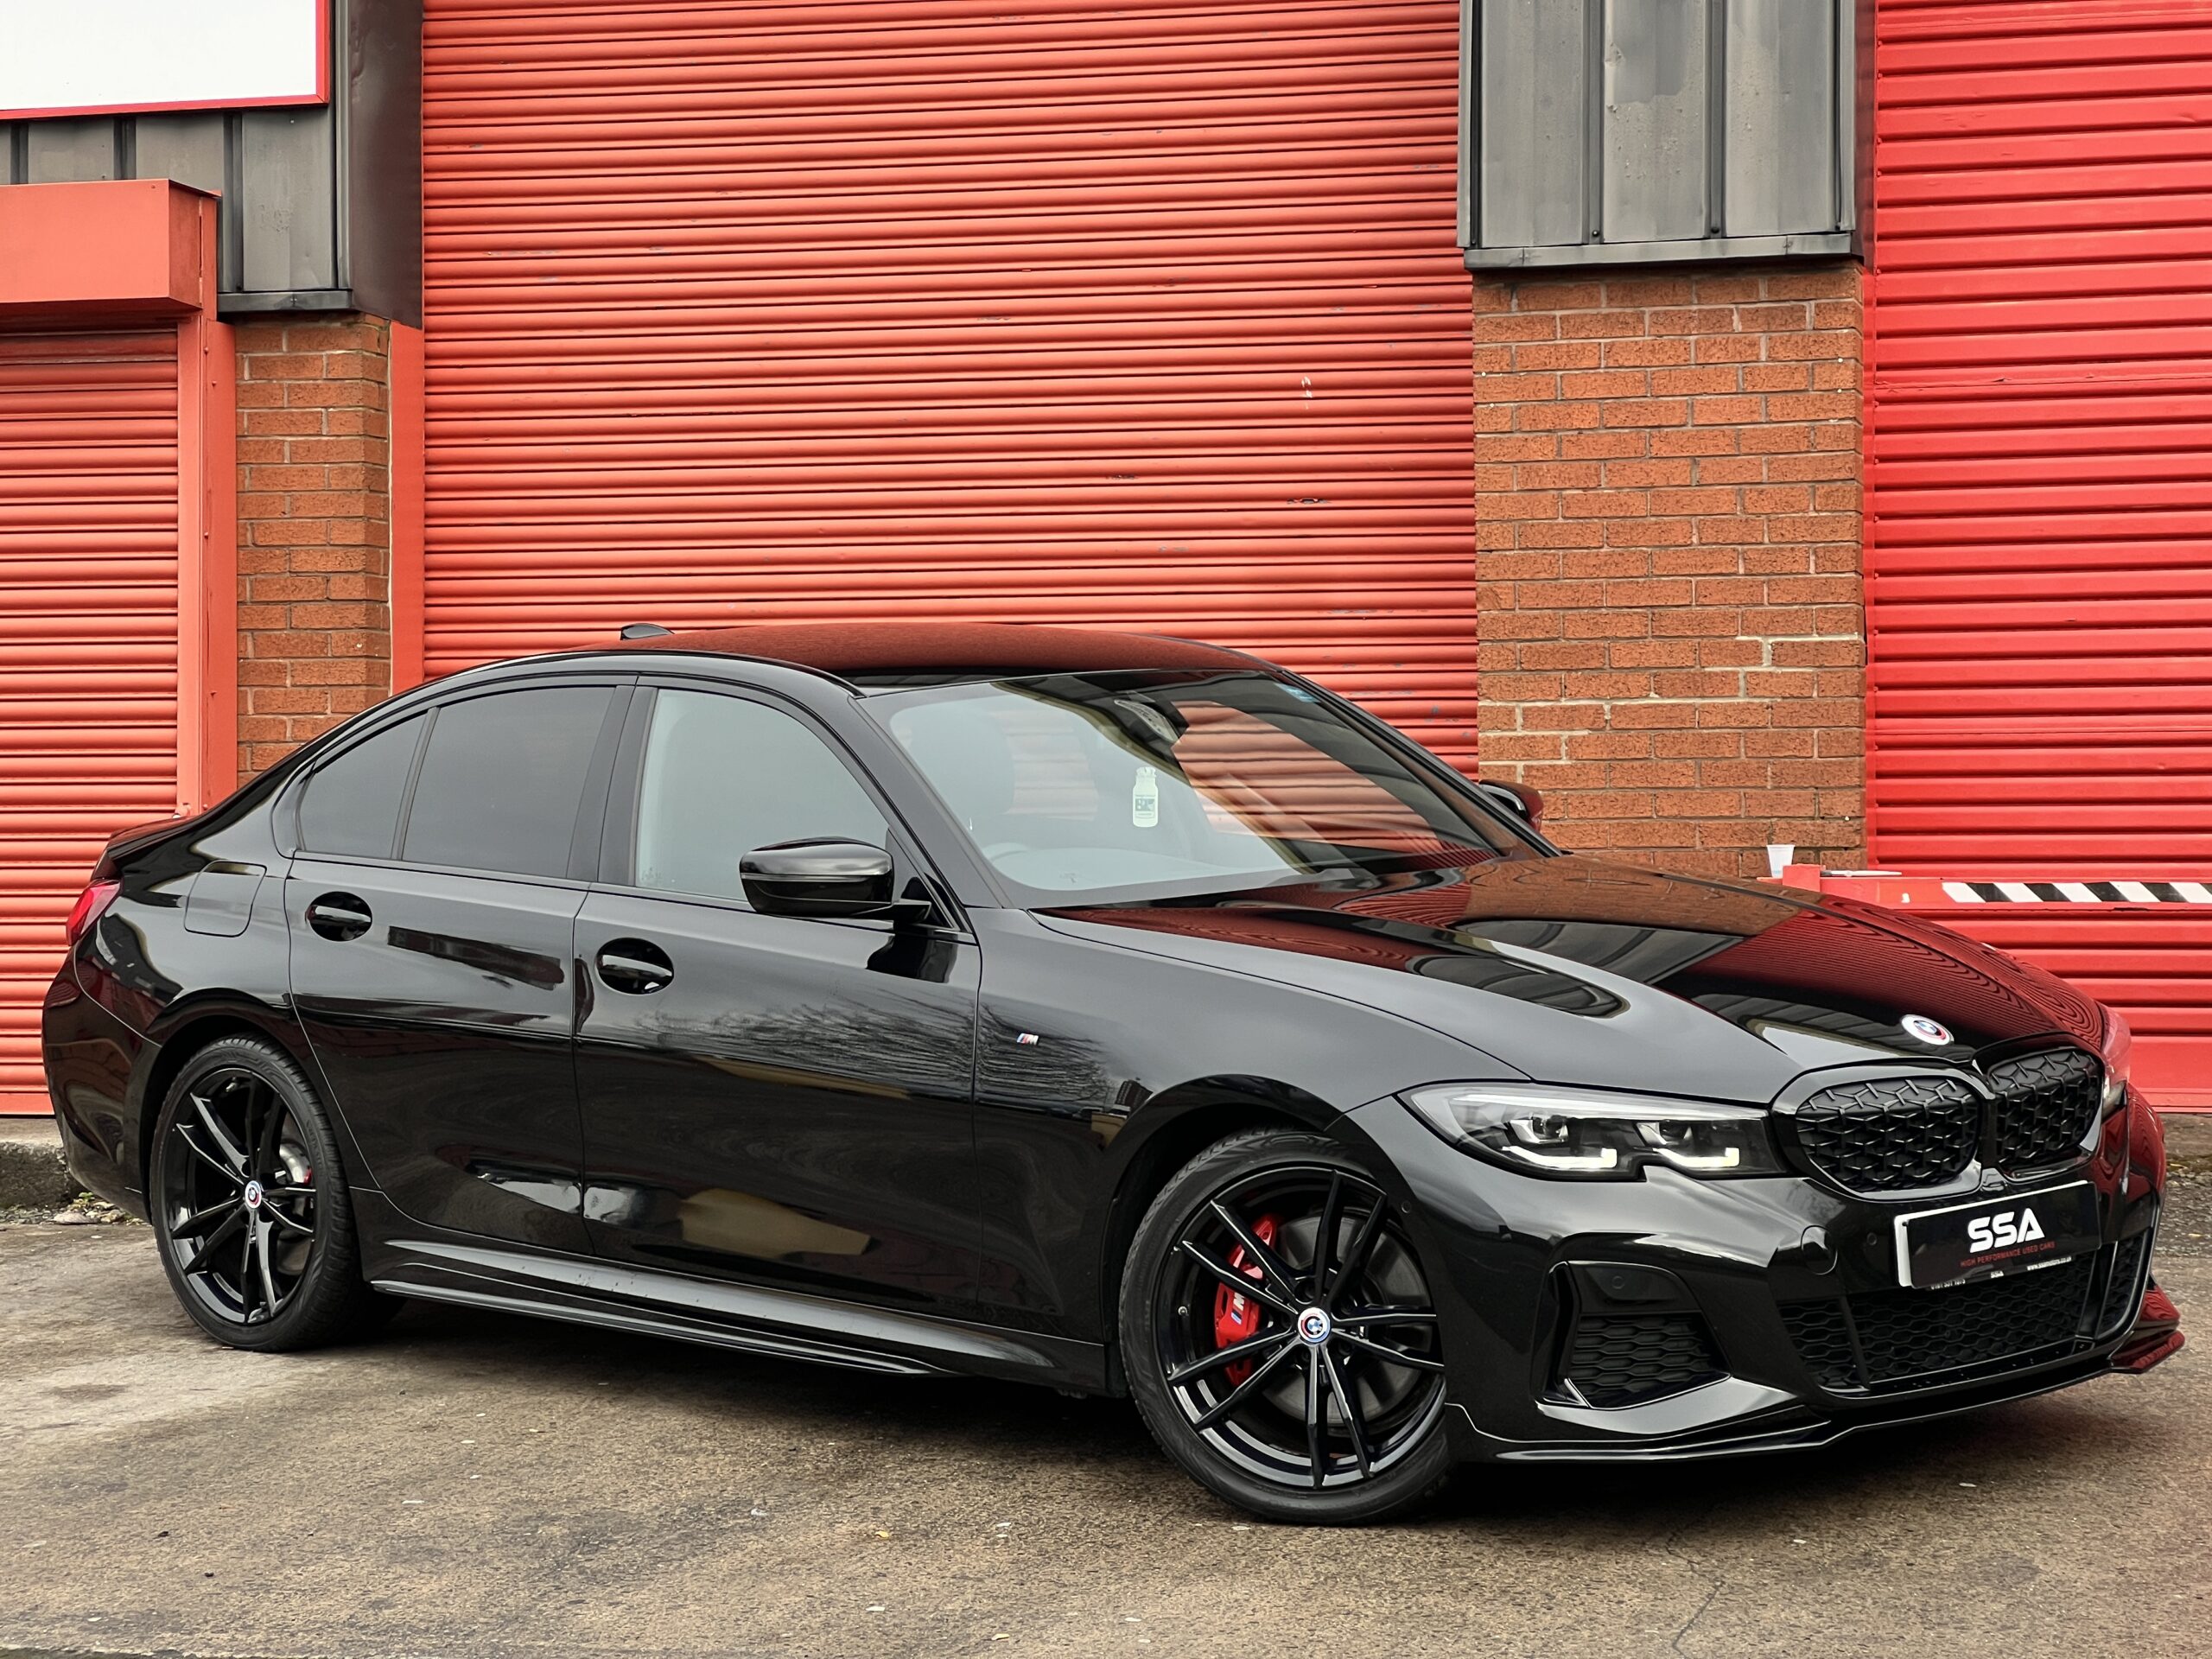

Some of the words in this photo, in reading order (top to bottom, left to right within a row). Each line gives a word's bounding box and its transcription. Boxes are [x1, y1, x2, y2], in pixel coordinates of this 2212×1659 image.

[1967, 1208, 2045, 1253] SSA
[1961, 1258, 1976, 1267] HIGH
[1977, 1249, 2021, 1263] PERFORMANCE
[2023, 1244, 2038, 1255] USED
[2040, 1241, 2056, 1250] CARS
